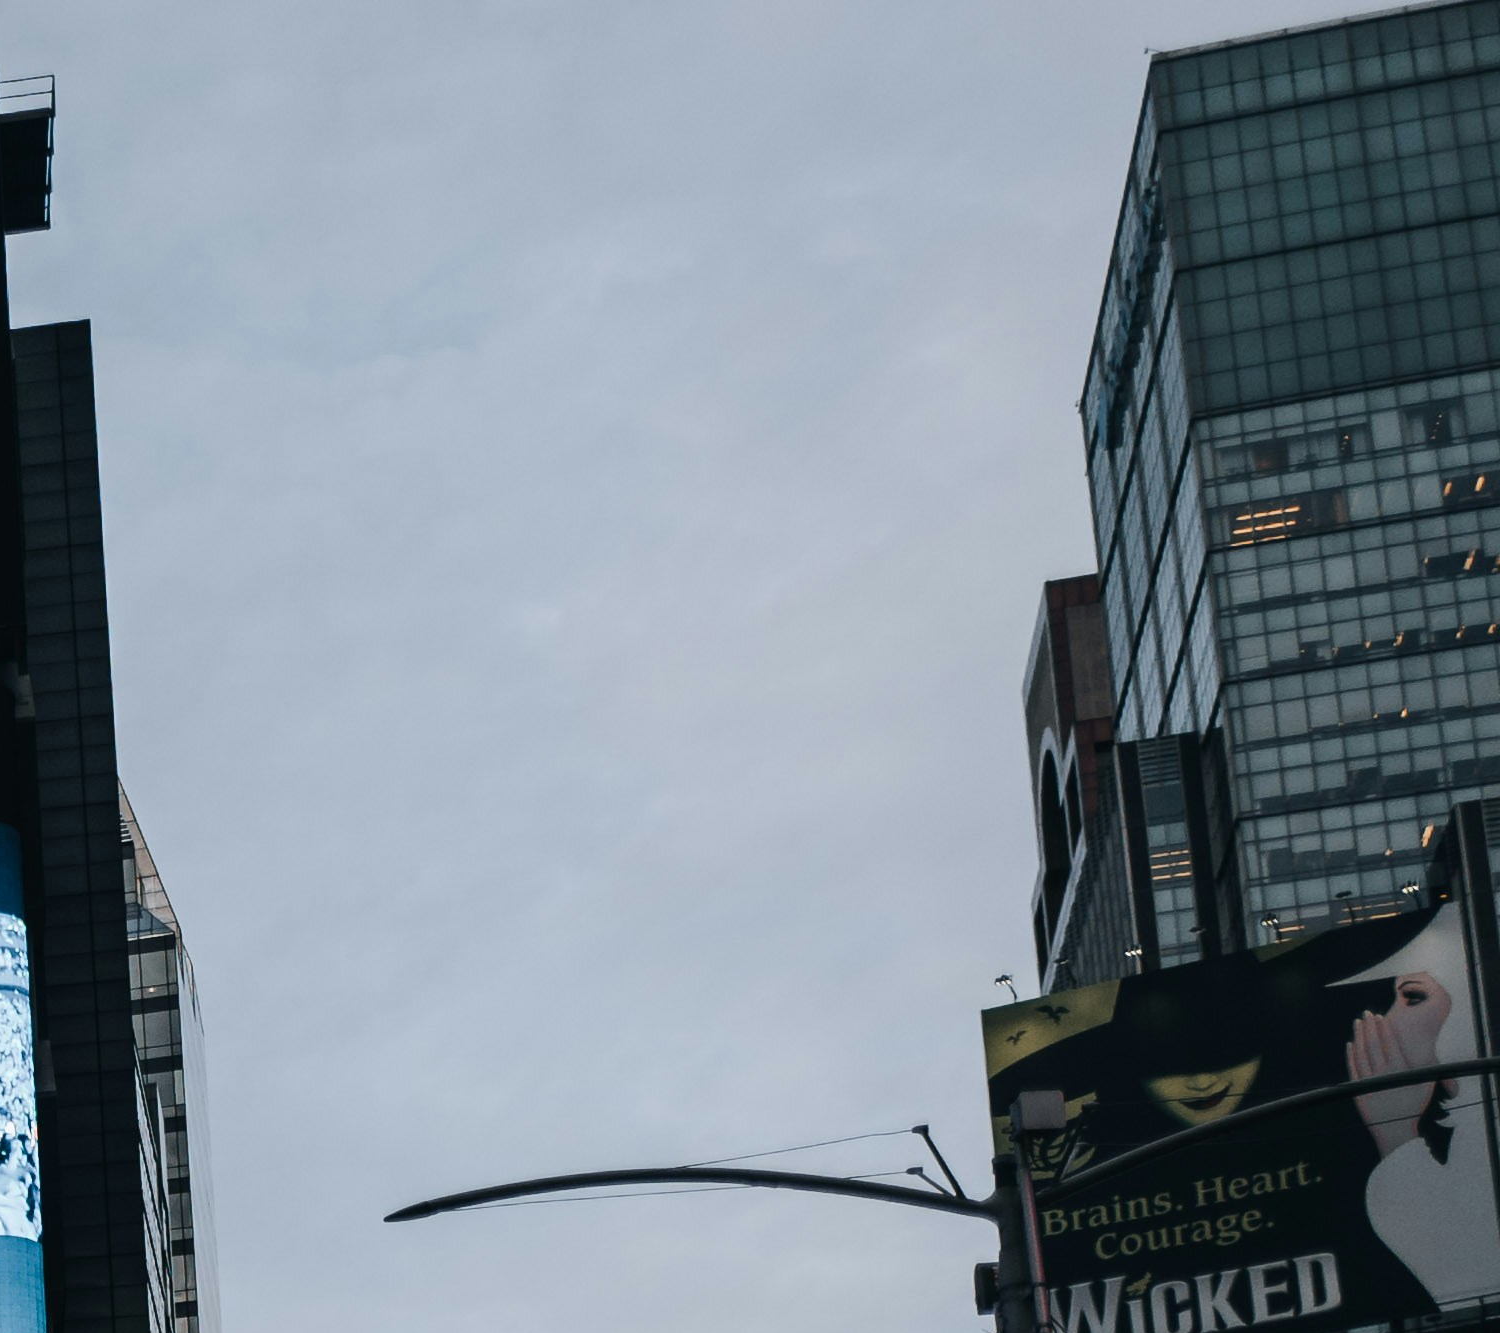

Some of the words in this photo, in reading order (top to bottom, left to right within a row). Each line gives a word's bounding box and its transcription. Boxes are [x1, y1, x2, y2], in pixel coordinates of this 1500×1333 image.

[1040, 1188, 1184, 1240] Brains.
[1194, 1158, 1324, 1210] Heart.
[1093, 1204, 1276, 1262] Courage.
